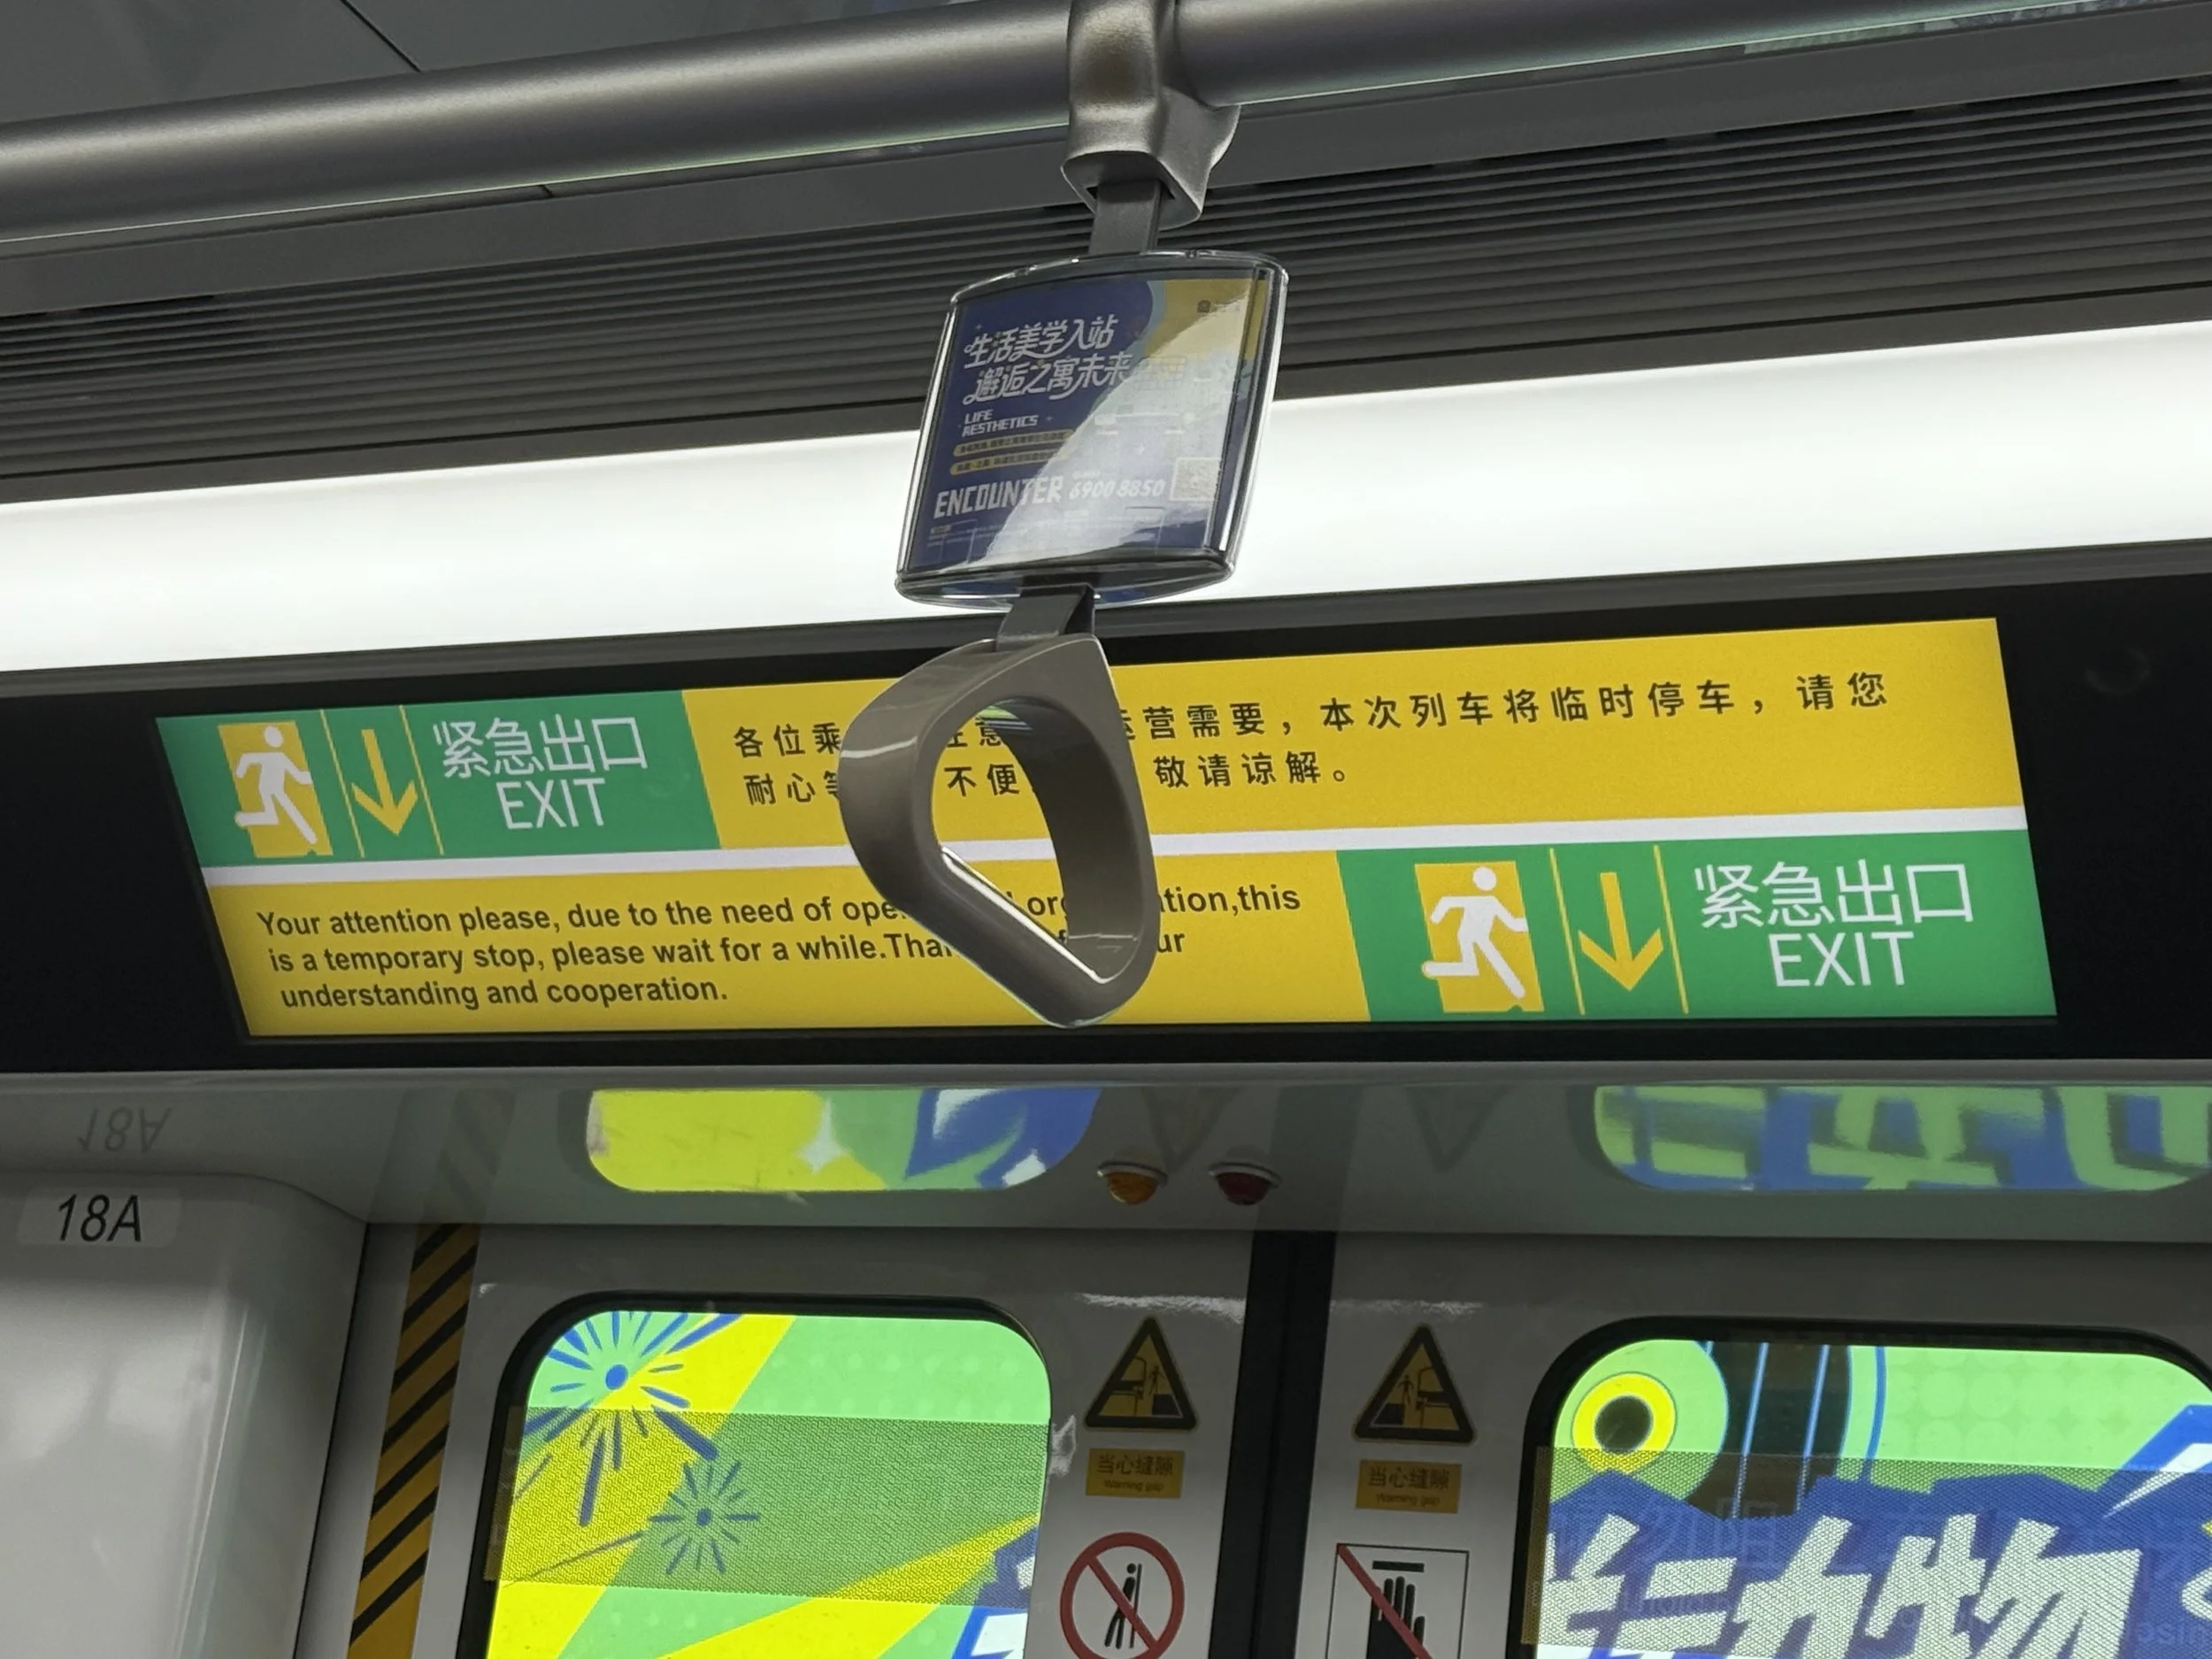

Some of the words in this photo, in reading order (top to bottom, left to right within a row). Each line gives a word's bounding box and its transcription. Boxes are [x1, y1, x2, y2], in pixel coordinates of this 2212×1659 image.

[964, 314, 1118, 369] 生活美学入站
[963, 349, 1133, 405] 邂逅之寓未来
[962, 415, 1039, 437] AESTHETICS
[964, 409, 993, 426] LIFE
[933, 475, 1064, 519] ENCOUNTER
[433, 714, 648, 779] 紧急出口
[496, 778, 605, 830] EXIT
[257, 910, 320, 936] Your
[329, 908, 451, 933] attention
[459, 905, 559, 937] please,
[568, 902, 620, 928] due
[627, 902, 657, 926] to
[665, 900, 712, 925] the
[721, 897, 794, 925] need
[803, 896, 832, 921] of
[1694, 859, 1974, 932] 紧急出口
[268, 949, 294, 972] is
[303, 951, 318, 971] a
[324, 948, 463, 975] temporary
[473, 944, 545, 972] stop,
[551, 941, 645, 972] please
[652, 938, 715, 964] wait
[720, 937, 762, 962] for
[772, 941, 789, 961] a
[796, 933, 953, 961] while.Tha
[1770, 931, 1915, 987] EXIT
[280, 980, 480, 1010] understanding
[488, 979, 538, 1004] and
[546, 976, 727, 1009] cooperation.
[57, 1194, 142, 1241] 18A
[1097, 1453, 1175, 1477] 当心缝隙
[1368, 1464, 1450, 1491] 当心缝隙
